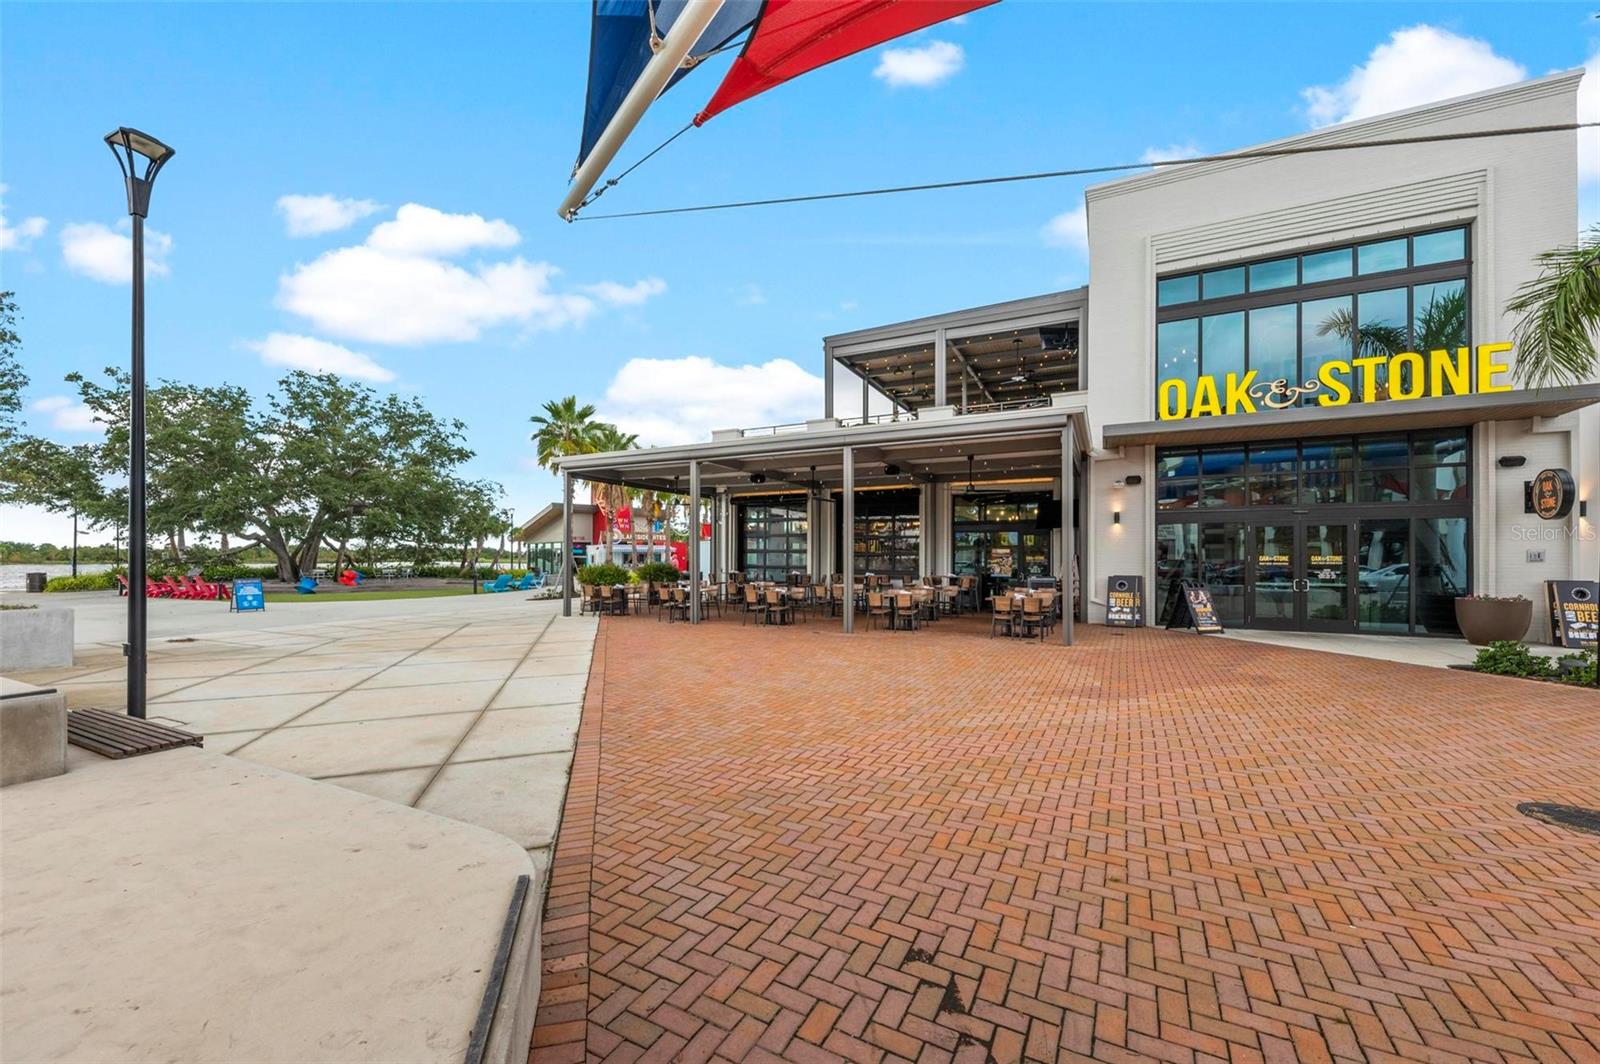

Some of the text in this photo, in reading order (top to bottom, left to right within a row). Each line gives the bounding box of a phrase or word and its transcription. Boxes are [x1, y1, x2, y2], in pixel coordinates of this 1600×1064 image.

[1159, 341, 1514, 421] OAK & STONE
[1116, 599, 1134, 607] BEER
[1563, 602, 1598, 611] CORNHOL
[1576, 610, 1598, 623] BEE
